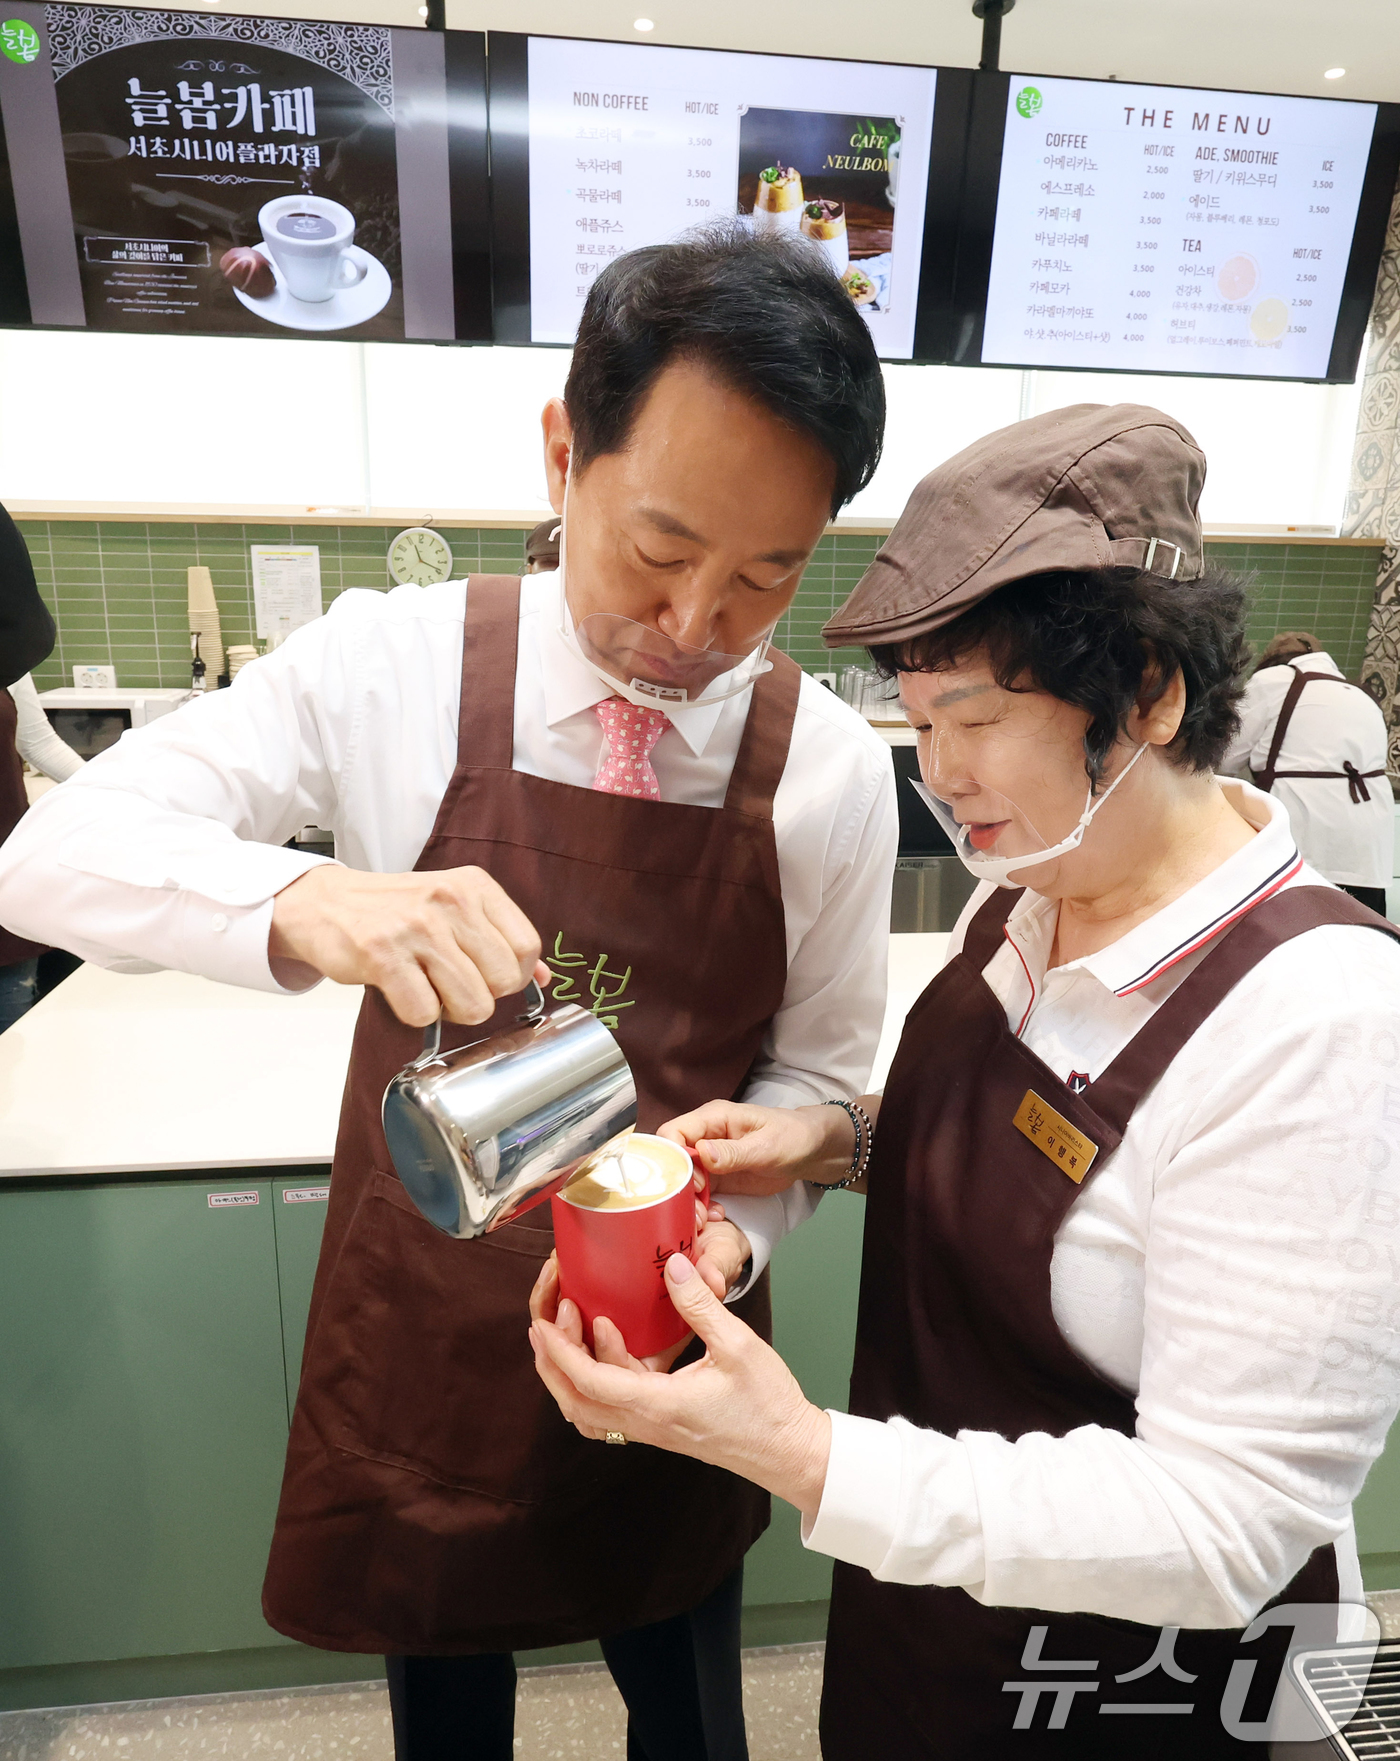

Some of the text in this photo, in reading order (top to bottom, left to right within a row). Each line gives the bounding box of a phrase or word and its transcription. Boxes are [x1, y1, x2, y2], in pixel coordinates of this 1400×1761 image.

[125, 77, 316, 136] 늘봄카페
[573, 91, 649, 111] NON COFFEE
[685, 101, 719, 115] HOT/ICE
[1124, 107, 1271, 136] THE MENU
[688, 137, 712, 147] 3,500
[850, 133, 888, 149] CAFE
[1045, 133, 1088, 149] COFFEE
[127, 135, 321, 167] 서초시니어플라자점
[1143, 144, 1175, 157] HOT/ICE
[1195, 146, 1279, 166] ADE, SMOOTHIE
[575, 157, 622, 175] 녹차라떼
[822, 154, 895, 173] NEULBOM
[1043, 154, 1098, 171] 아메리카노
[1321, 160, 1335, 172] ICE
[687, 169, 711, 178] 3,500
[1146, 165, 1169, 175] 2,500
[1193, 169, 1214, 185] 딸기
[1225, 171, 1277, 188] 키위스무디
[1312, 180, 1334, 189] 3,500
[575, 187, 622, 204] 곡물라떼
[1041, 181, 1095, 197] 에스프레소
[1143, 191, 1165, 200] 2,000
[686, 198, 710, 207] 3,500
[1189, 194, 1220, 209] 에이드
[1308, 205, 1330, 214] 3,500
[575, 217, 624, 234] 애플쥬스
[1139, 216, 1161, 225] 3,500
[1035, 231, 1089, 248] 바닐라라떼
[1136, 241, 1158, 250] 3,500
[1182, 239, 1201, 252] TEA
[1292, 248, 1322, 260] HOT/ICE
[1032, 258, 1072, 273] 카푸치노
[1133, 264, 1154, 273] 3,500
[1178, 264, 1215, 277] 아이스티
[1296, 274, 1317, 282] 2,500
[1029, 281, 1070, 295] 카페모카
[1129, 290, 1151, 298] 4,000
[1291, 299, 1312, 307] 2,500
[1126, 313, 1147, 321] 4,000
[1287, 325, 1307, 334] 3,500
[1123, 334, 1144, 342] 4,000
